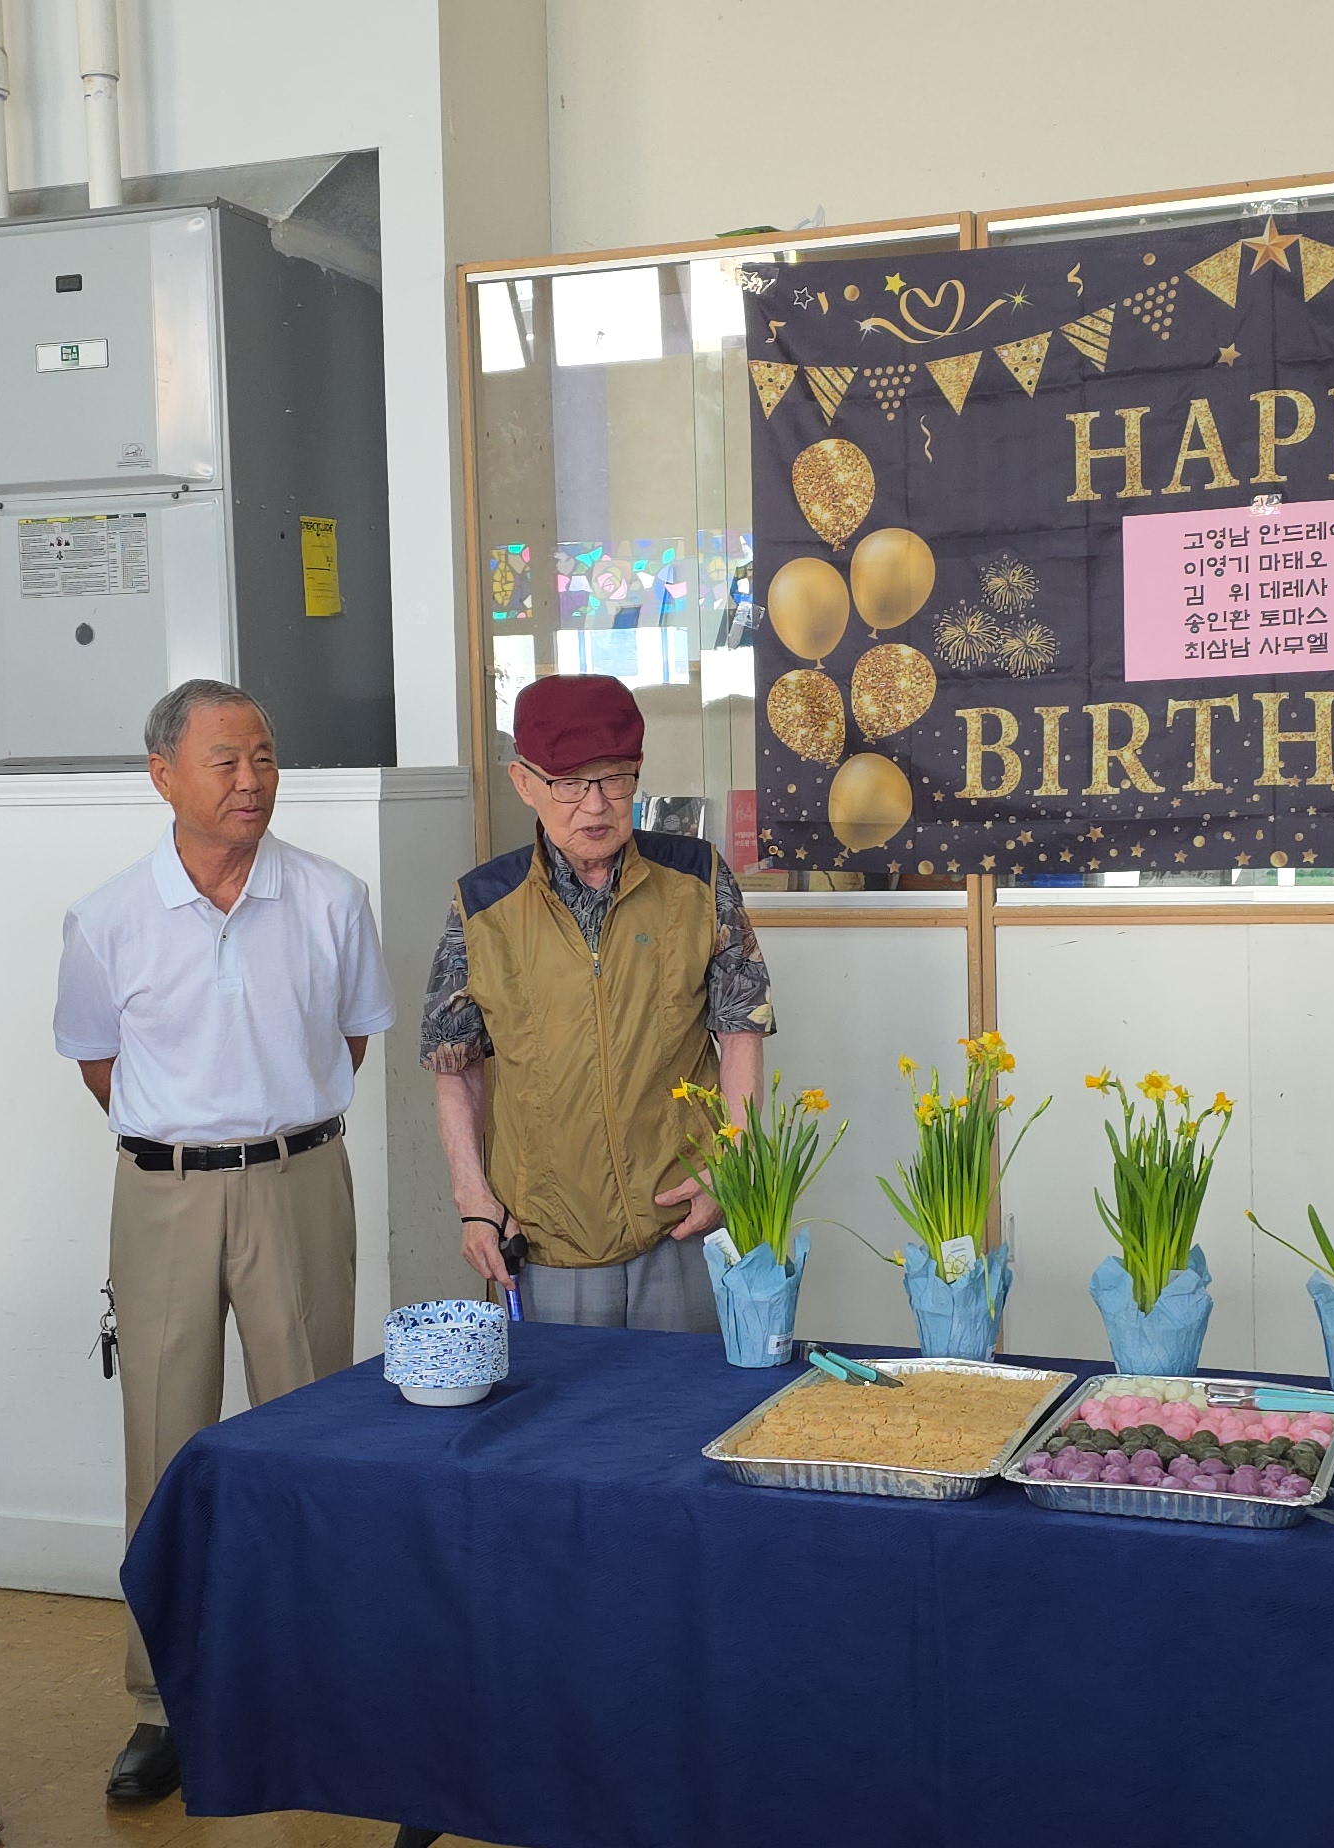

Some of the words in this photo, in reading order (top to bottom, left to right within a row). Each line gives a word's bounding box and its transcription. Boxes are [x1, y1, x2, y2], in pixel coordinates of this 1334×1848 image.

[1183, 525, 1250, 550] 고영남
[1183, 553, 1250, 578] 이영기
[1259, 550, 1328, 573] 마태오
[1183, 583, 1205, 606] 김
[1229, 582, 1250, 603] 위
[1259, 577, 1328, 600] 데레사
[1184, 608, 1251, 634] 송인환
[1259, 606, 1328, 627] 토마스
[1184, 636, 1251, 660] 최삼남
[1259, 632, 1329, 656] 사무엘
